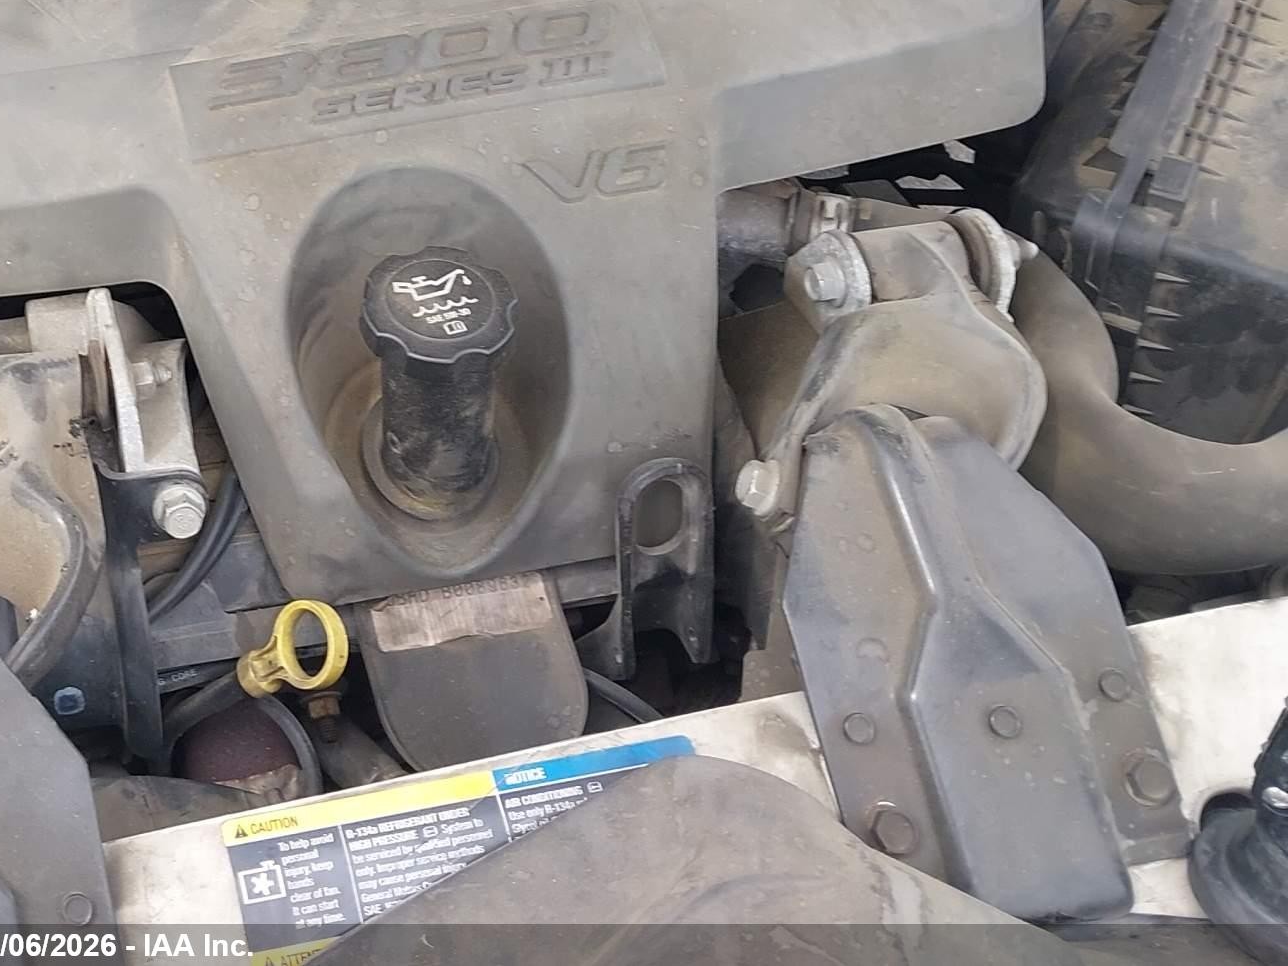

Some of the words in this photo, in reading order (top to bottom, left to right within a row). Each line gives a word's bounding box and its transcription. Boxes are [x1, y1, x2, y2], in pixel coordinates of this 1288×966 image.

[208, 9, 610, 111] 3800
[312, 63, 528, 125] SERIES
[518, 140, 669, 204] V6
[504, 767, 547, 785] NOTICE
[505, 797, 521, 809] AIR
[521, 786, 584, 805] CONDITIONING
[250, 817, 299, 834] CAUTION
[345, 825, 379, 840] R-134a
[378, 813, 438, 832] REFRIGERANT
[438, 807, 470, 821] UNDER
[279, 841, 290, 851] To
[291, 838, 309, 850] help
[310, 833, 334, 845] avoid
[349, 839, 372, 852] HIGH
[372, 830, 419, 846] PRESSURE
[441, 820, 474, 836] System
[365, 846, 402, 862] serviced
[452, 829, 494, 847] personnel
[281, 849, 319, 866] personal
[415, 853, 447, 866] service
[311, 861, 334, 874] keep
[287, 878, 314, 890] hands
[290, 890, 312, 903] clear
[301, 904, 318, 914] can
[319, 899, 339, 911] start
